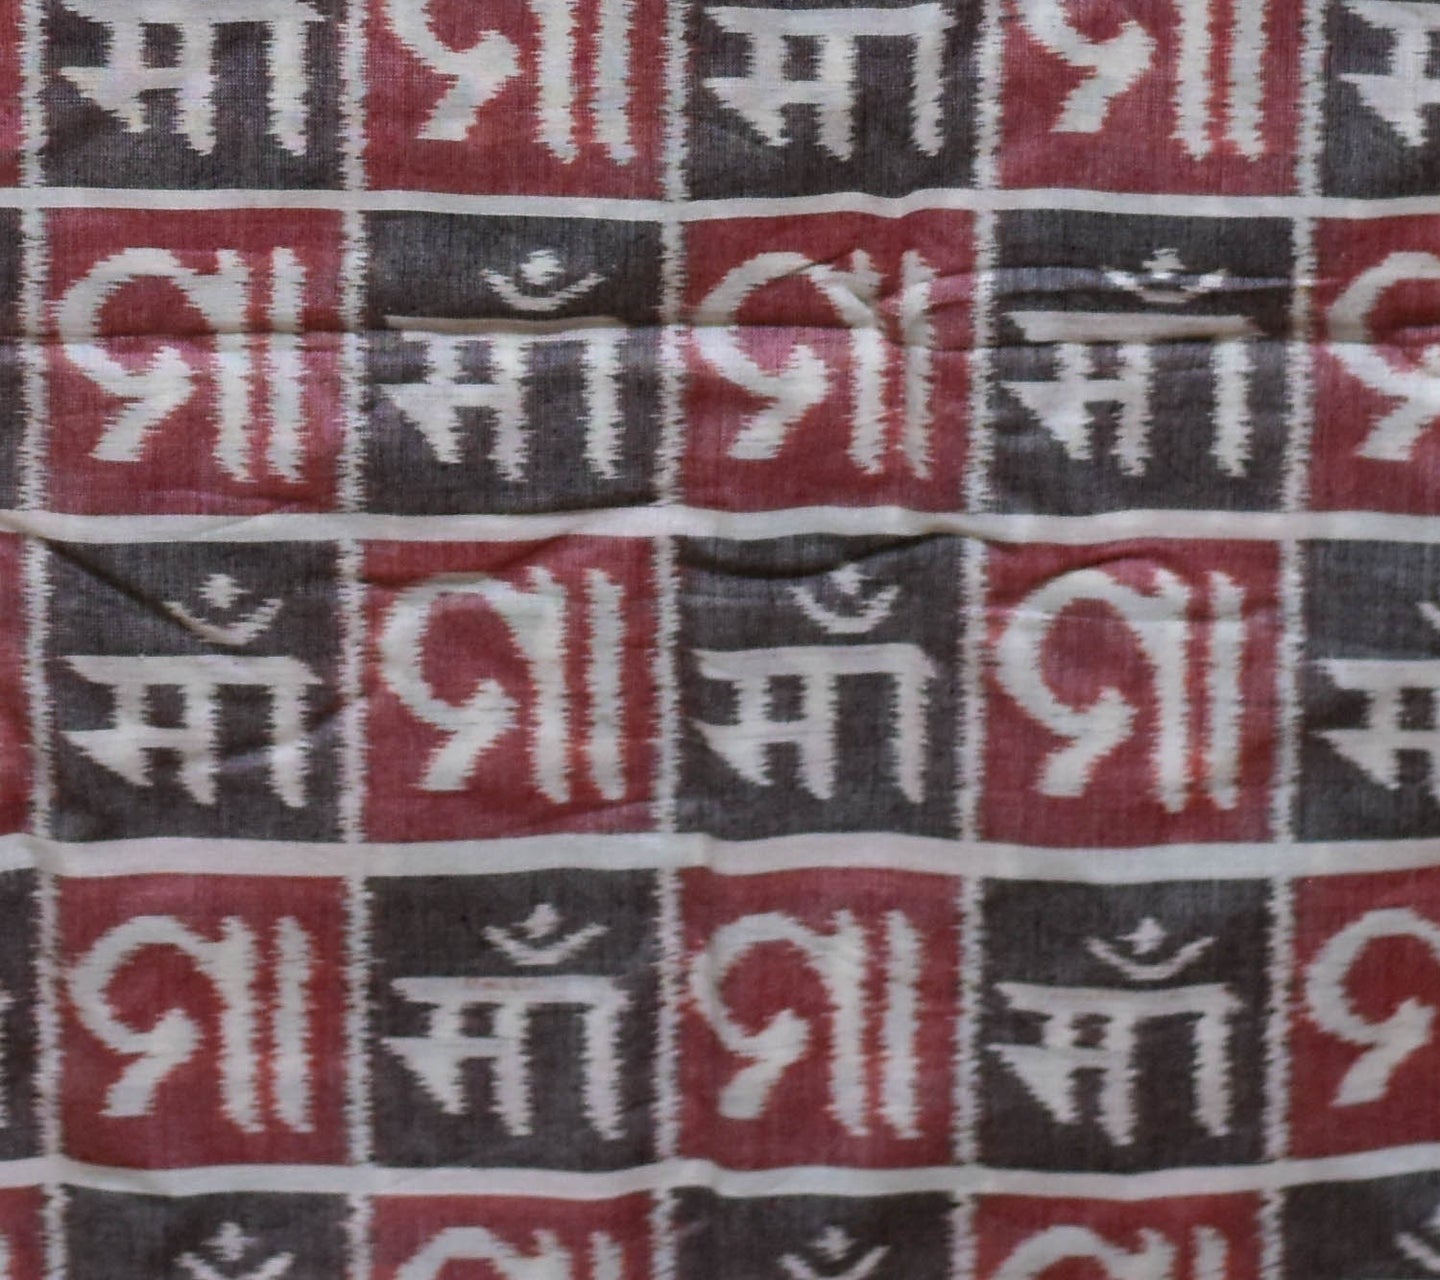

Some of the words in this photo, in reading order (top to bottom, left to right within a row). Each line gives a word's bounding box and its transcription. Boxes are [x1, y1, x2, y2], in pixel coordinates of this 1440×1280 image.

[382, 249, 647, 480] माँ
[698, 564, 936, 802] माँ
[384, 904, 629, 1139] माँ
[990, 918, 1241, 1145] माँ
